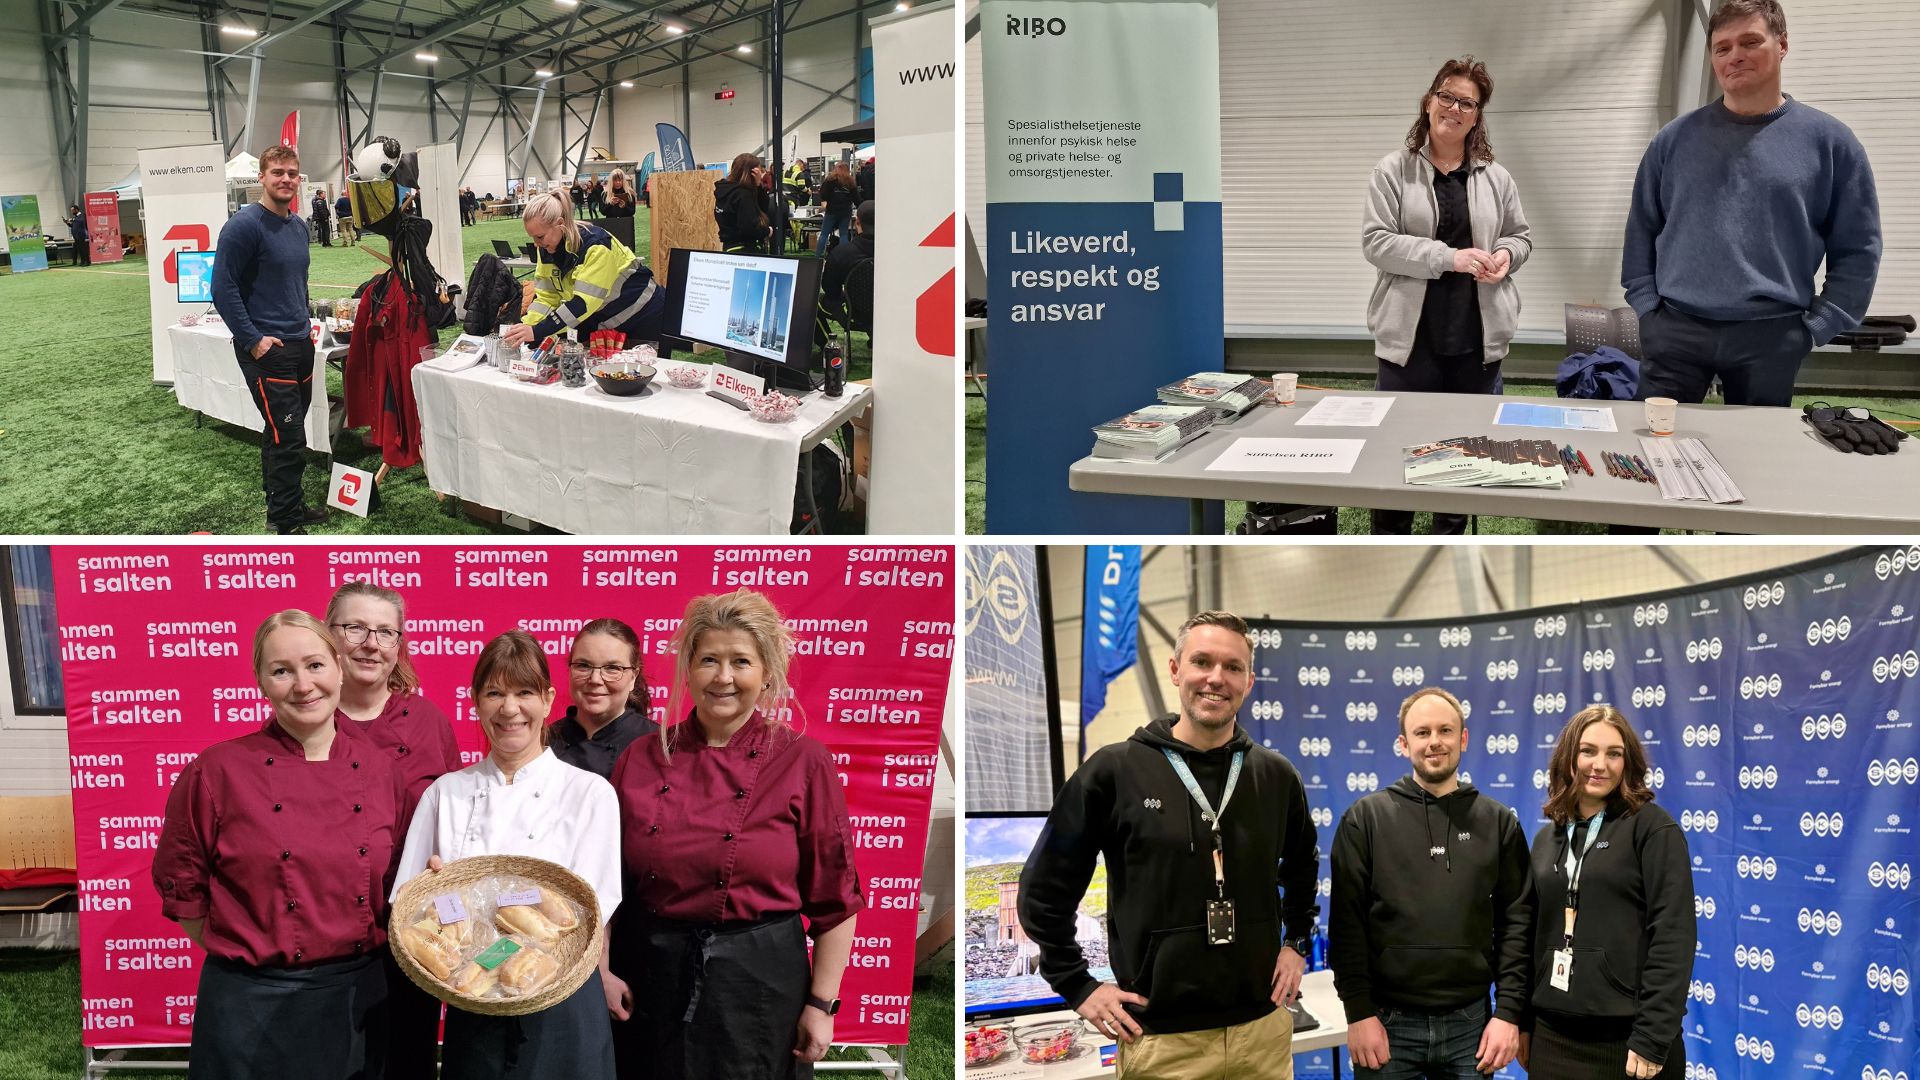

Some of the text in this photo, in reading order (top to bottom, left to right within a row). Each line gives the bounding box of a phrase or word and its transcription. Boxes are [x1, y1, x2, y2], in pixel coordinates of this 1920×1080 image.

[1006, 14, 1066, 39] RIBO
[1008, 119, 1141, 132] Spesialisthelsetjeneste
[1008, 135, 1137, 148] innenfor psykisk helse
[1008, 152, 1122, 164] og private helse- og
[149, 164, 214, 176] www.elkem.com
[1008, 167, 1113, 180] omsorgstjenester.
[1011, 231, 1136, 257] Likeverd,
[1011, 264, 1160, 292] respekt og
[1011, 302, 1106, 323] ansvar
[725, 375, 757, 397] Elkem
[77, 553, 170, 571] sammen
[202, 550, 295, 567] sammen
[327, 550, 421, 565] sammen
[454, 549, 548, 564] sammen
[582, 548, 678, 563] sammen
[712, 548, 812, 562] sammen
[846, 547, 948, 563] sammen
[80, 571, 172, 593] i salten
[204, 568, 296, 590] i salten
[329, 567, 336, 587] i
[455, 566, 548, 587] i salten
[582, 566, 677, 587] i salten
[711, 565, 809, 587] i salten
[843, 565, 944, 588] i salten
[146, 619, 237, 637] sammen
[148, 637, 239, 659] i salten
[407, 635, 484, 656] salten
[642, 635, 650, 655] i
[900, 637, 954, 659] i sal
[91, 687, 180, 703] sammen
[829, 686, 923, 702] sammen
[92, 705, 182, 725] i salten
[213, 703, 221, 722] i
[456, 702, 462, 721] i
[826, 704, 921, 724] i salten
[156, 768, 164, 787] i
[881, 768, 890, 787] i
[99, 815, 165, 829] samm
[100, 831, 107, 850] i
[867, 890, 875, 909] i
[104, 937, 191, 951] sammen
[105, 952, 192, 971] i salten
[165, 1009, 172, 1025] i
[859, 1007, 866, 1023] i
